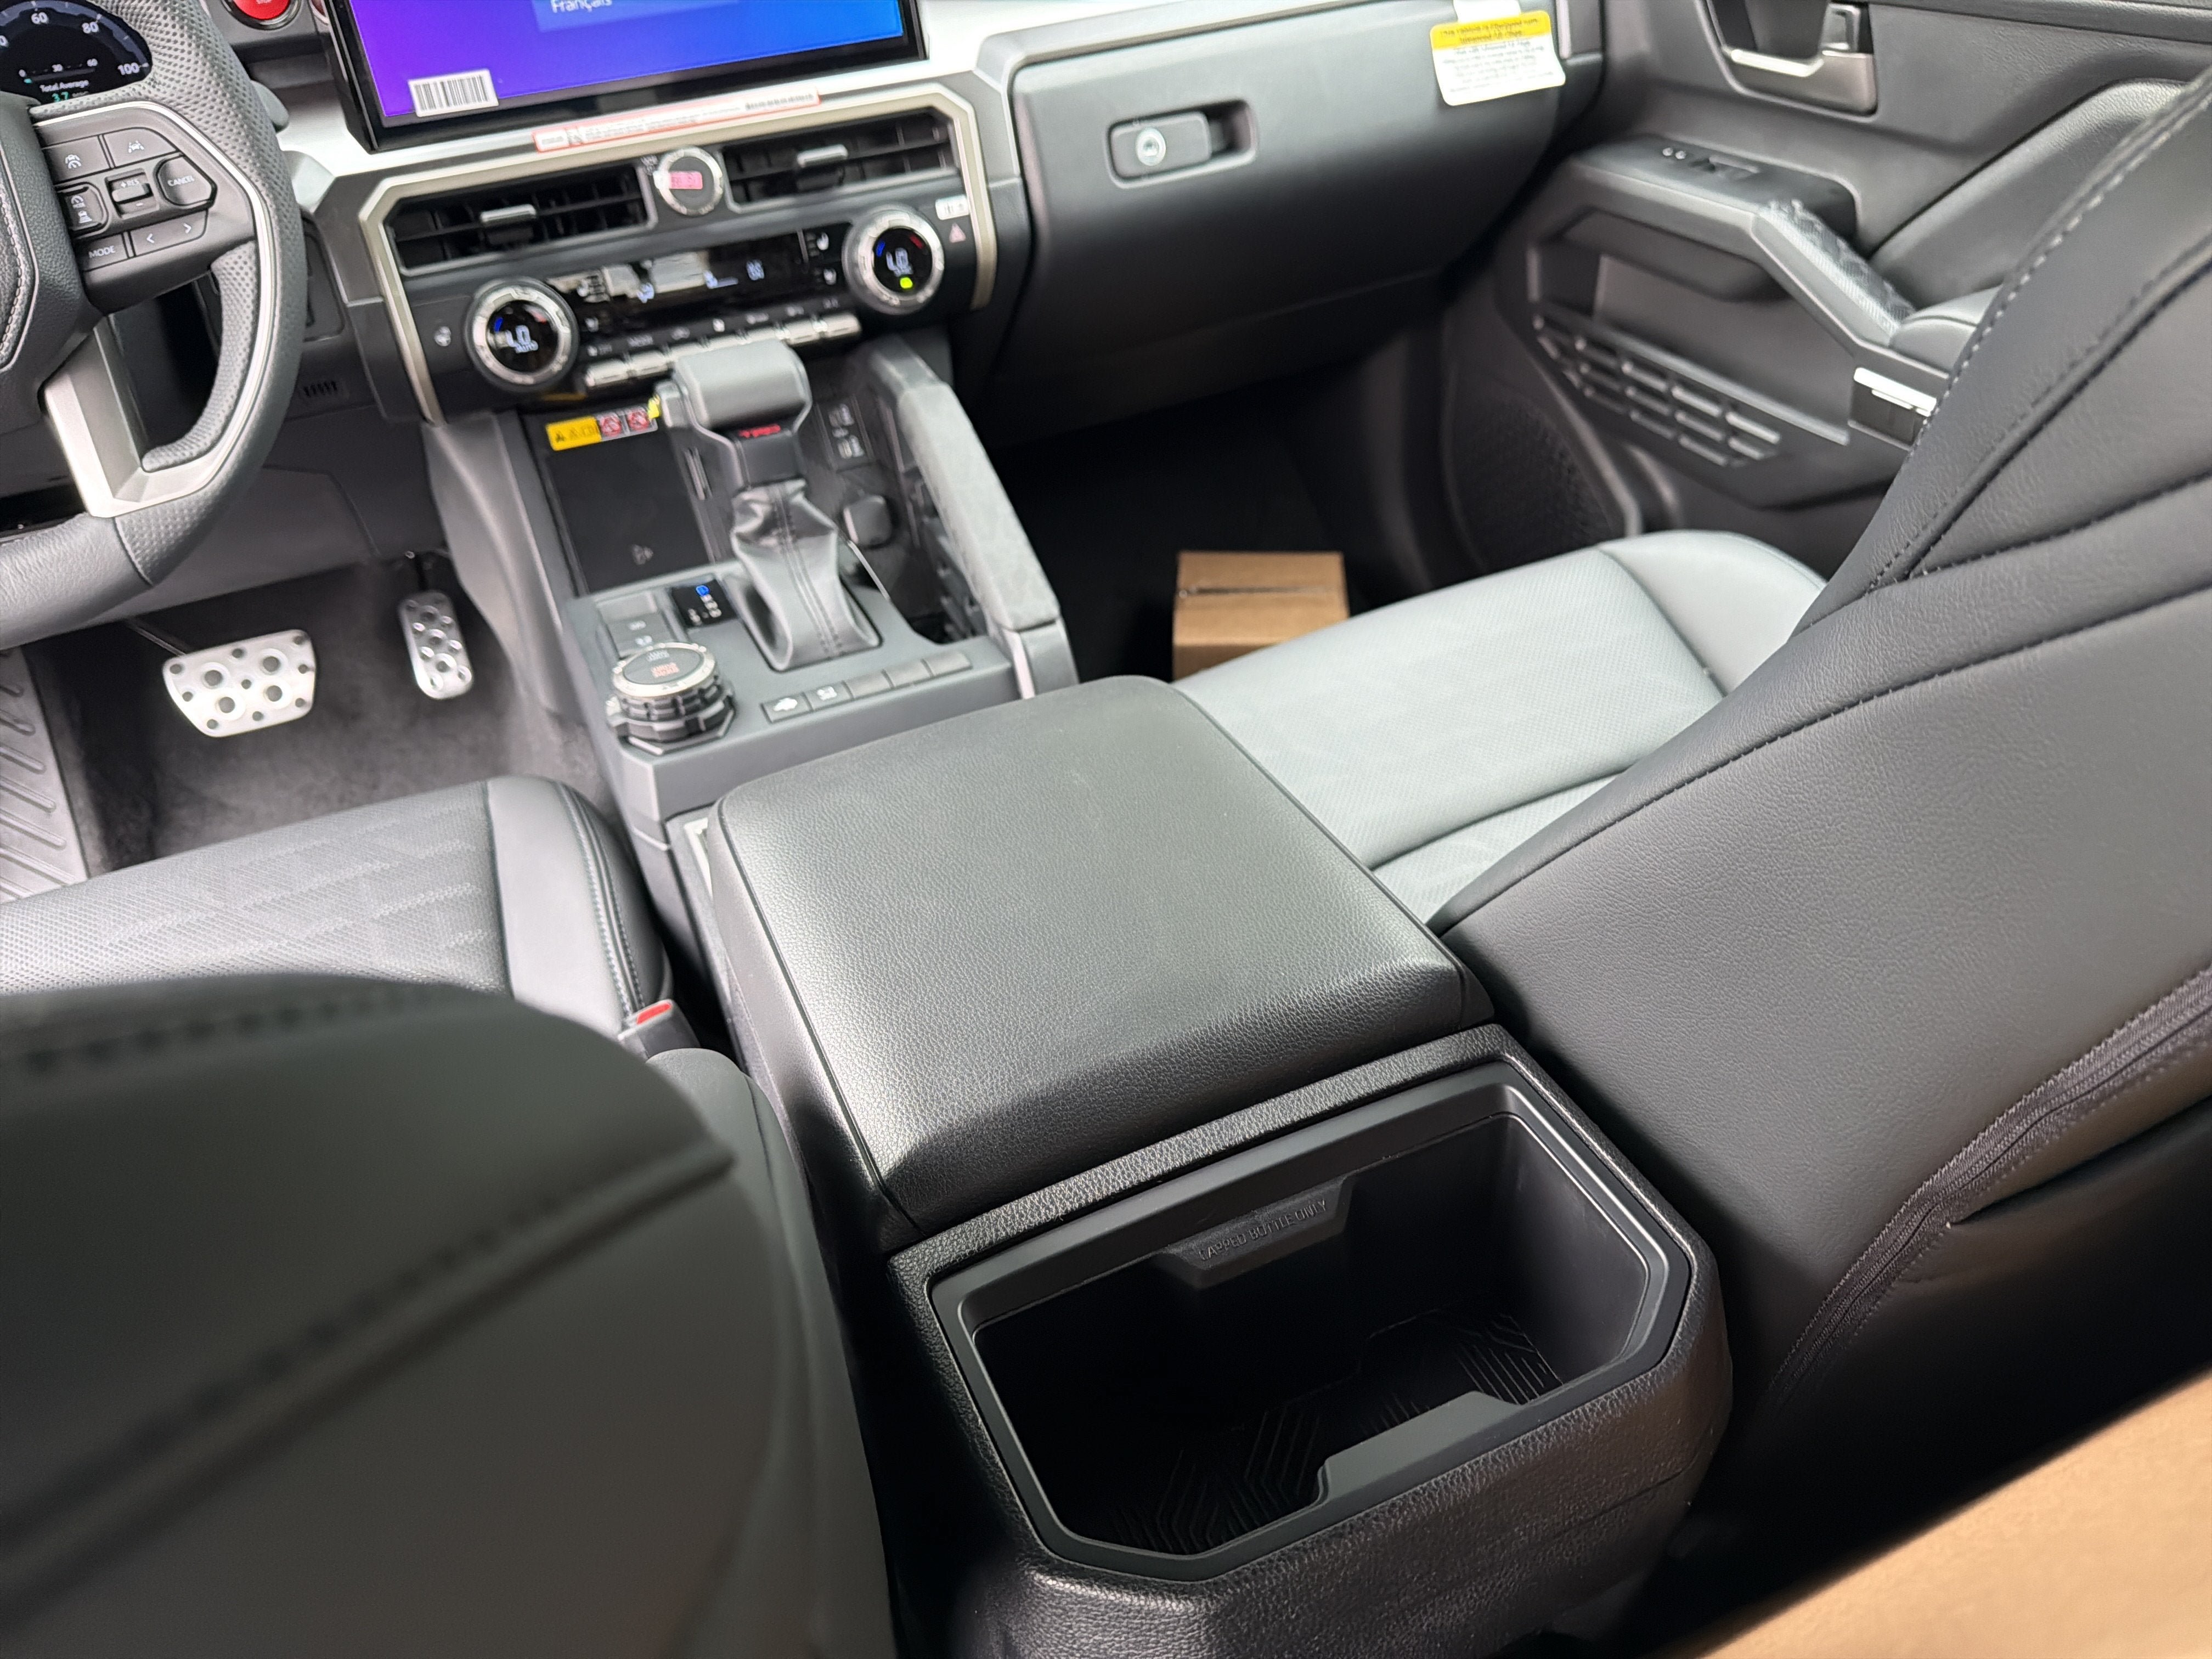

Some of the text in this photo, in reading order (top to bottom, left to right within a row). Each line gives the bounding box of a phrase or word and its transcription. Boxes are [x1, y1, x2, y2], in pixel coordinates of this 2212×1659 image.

[31, 12, 48, 25] 60
[82, 21, 99, 34] 80
[117, 62, 140, 76] 100
[40, 80, 89, 92] Total Average
[88, 245, 115, 258] MODE
[1199, 1198, 1327, 1261] CAPPED BOTTLE ONLY
